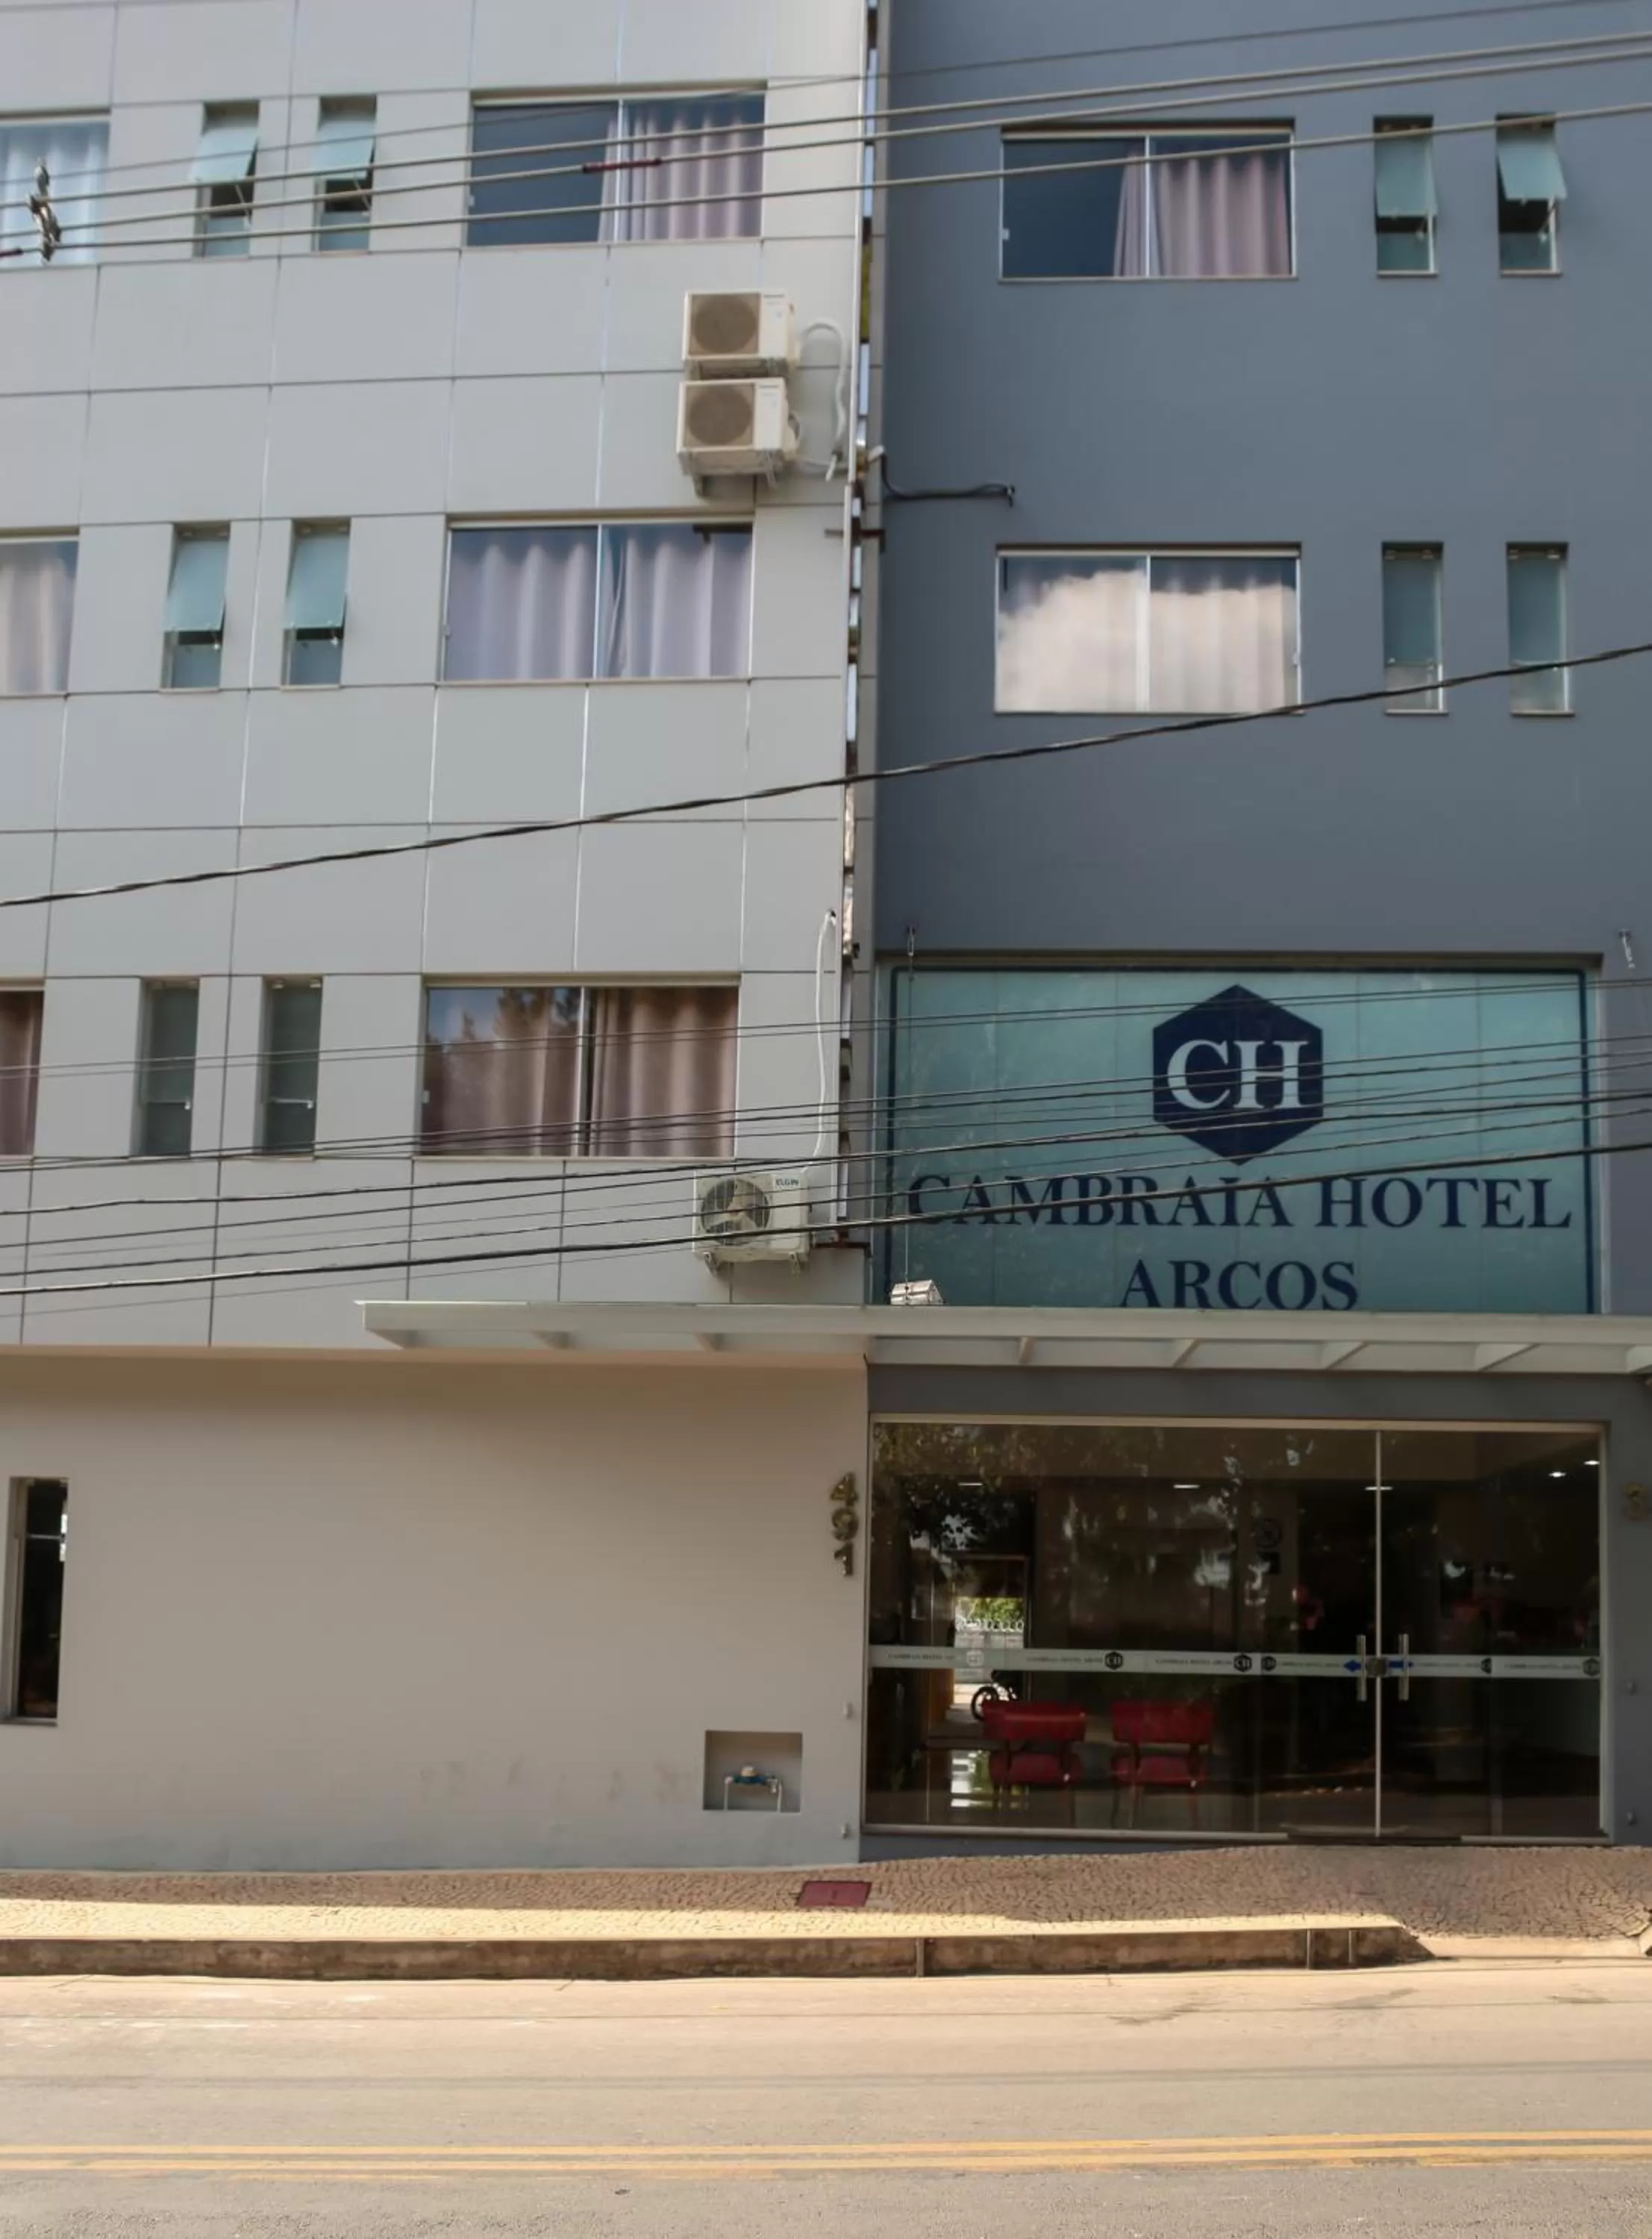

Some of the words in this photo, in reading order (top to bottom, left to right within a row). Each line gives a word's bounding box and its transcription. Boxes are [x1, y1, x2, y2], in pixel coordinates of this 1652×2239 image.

[1167, 1039, 1310, 1110] CH
[908, 1174, 1294, 1226] CAMBRAIA
[1314, 1177, 1572, 1228] HOTEL
[1120, 1259, 1359, 1311] ARCOS
